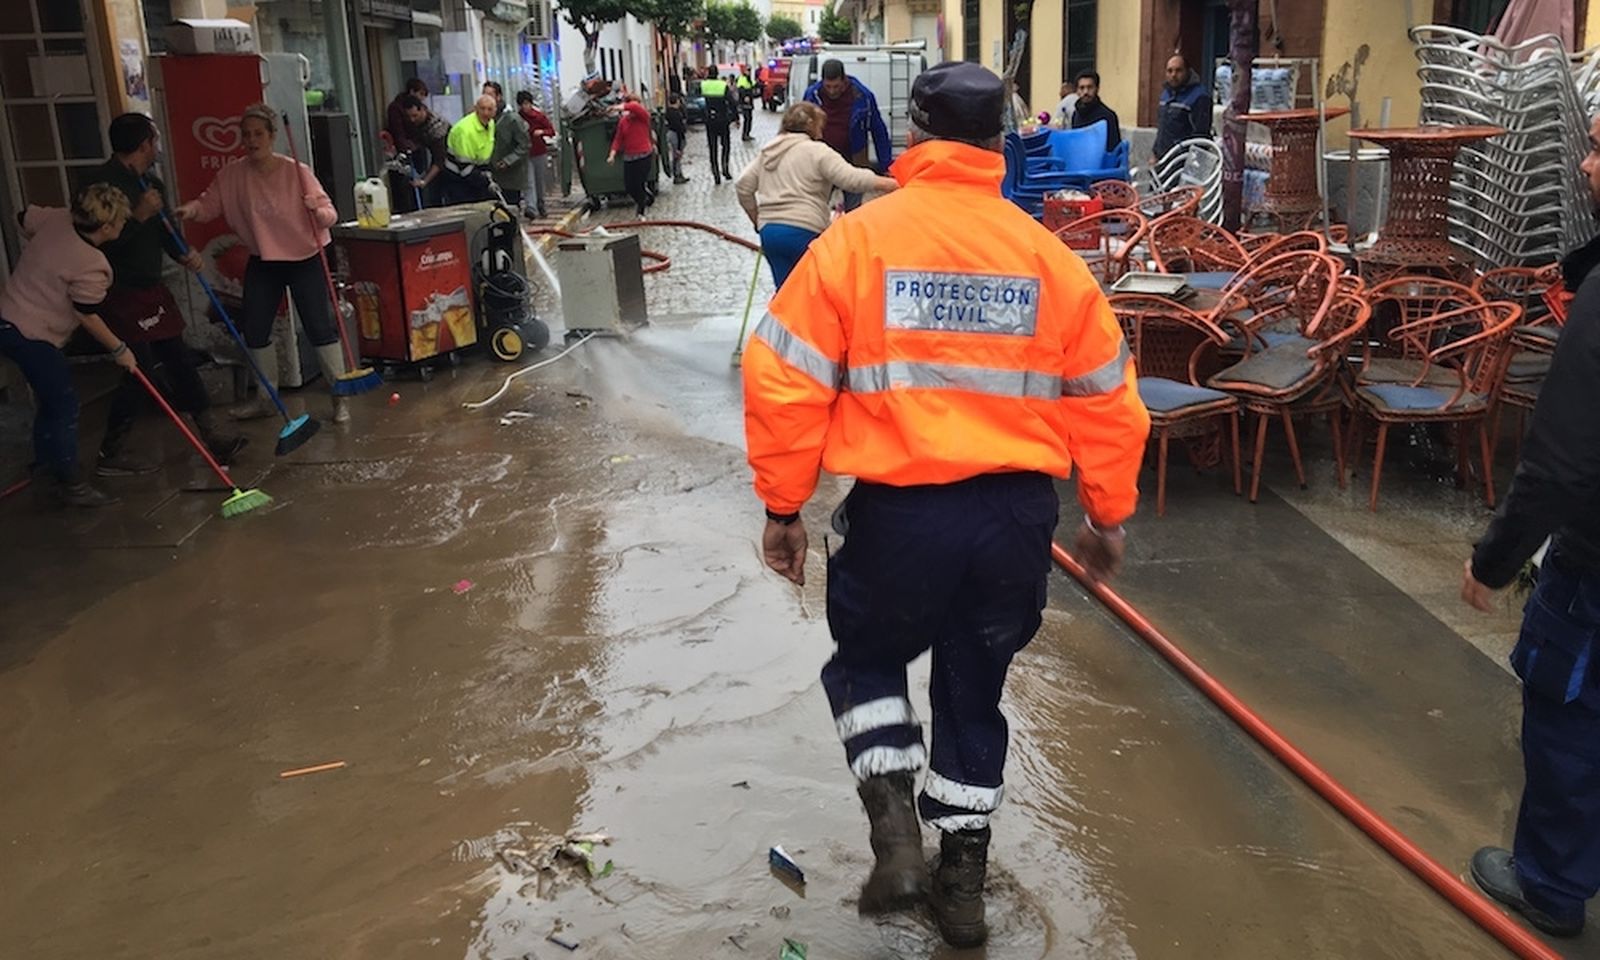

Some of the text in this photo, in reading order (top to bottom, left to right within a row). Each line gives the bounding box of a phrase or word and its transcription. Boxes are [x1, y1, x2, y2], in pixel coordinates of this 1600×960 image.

[200, 155, 238, 169] FRIG
[895, 280, 1030, 305] PROTECCIÓN
[934, 304, 987, 323] CIVIL
